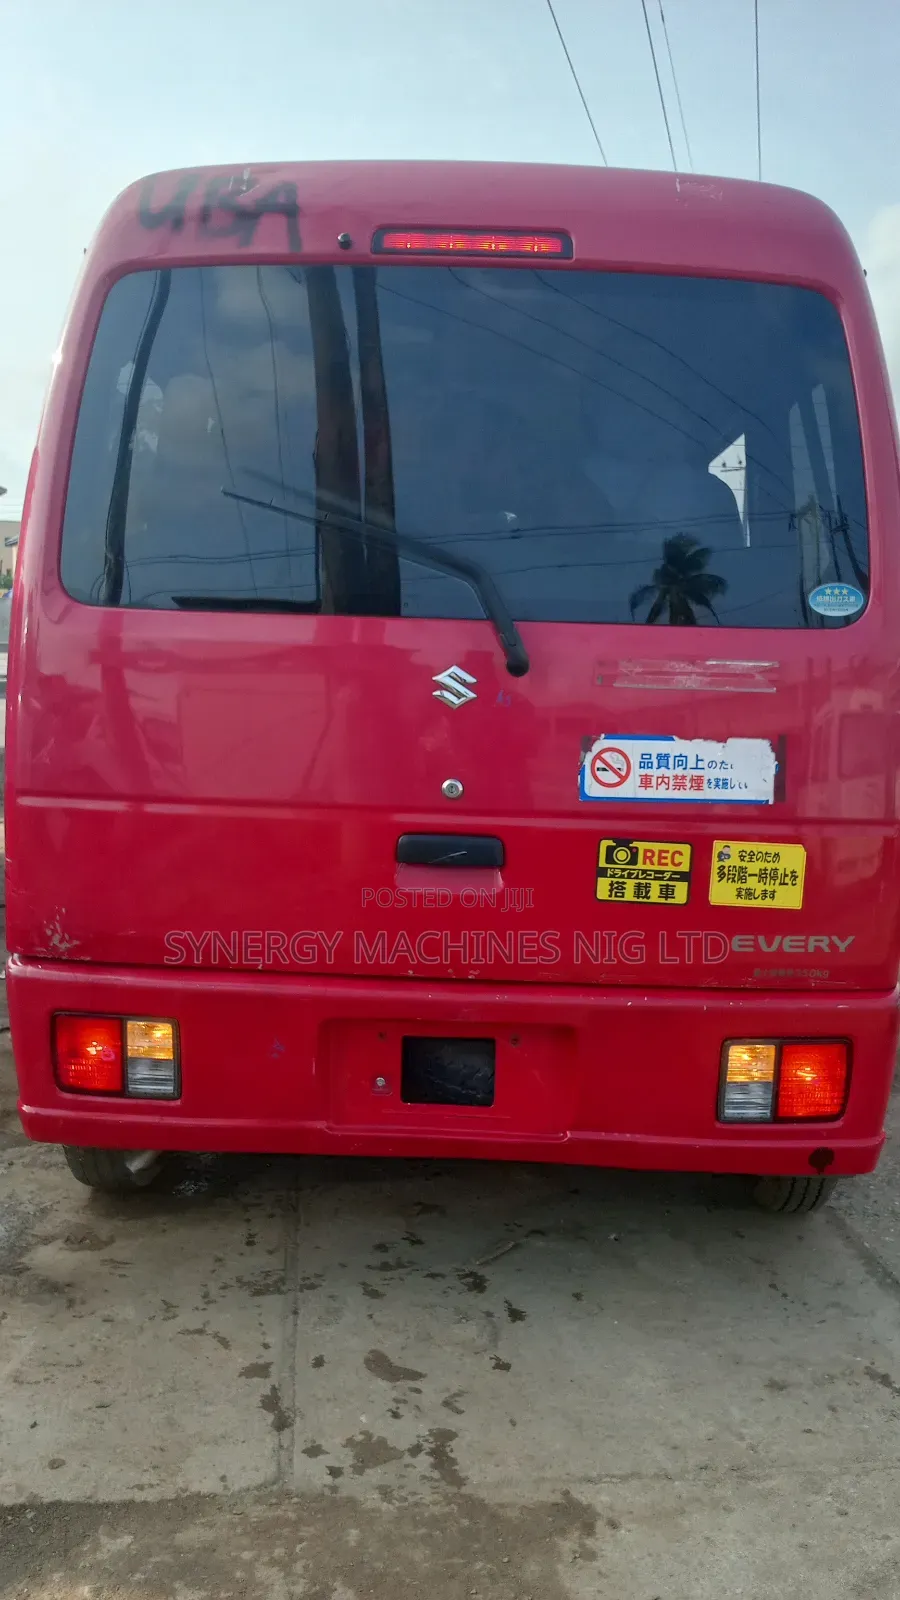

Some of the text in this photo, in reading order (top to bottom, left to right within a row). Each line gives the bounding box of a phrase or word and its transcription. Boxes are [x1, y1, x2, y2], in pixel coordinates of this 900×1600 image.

[638, 753, 734, 770] 品質向上のた
[638, 773, 748, 791] 車内禁煙を実施し
[642, 848, 684, 867] REC
[738, 850, 781, 863] 安全のため
[607, 868, 681, 880] ドライブレコーダー
[717, 865, 799, 886] 多段階一時停止を
[608, 880, 676, 900] 搭載車
[735, 887, 777, 901] 実施します
[731, 935, 856, 953] EVERY
